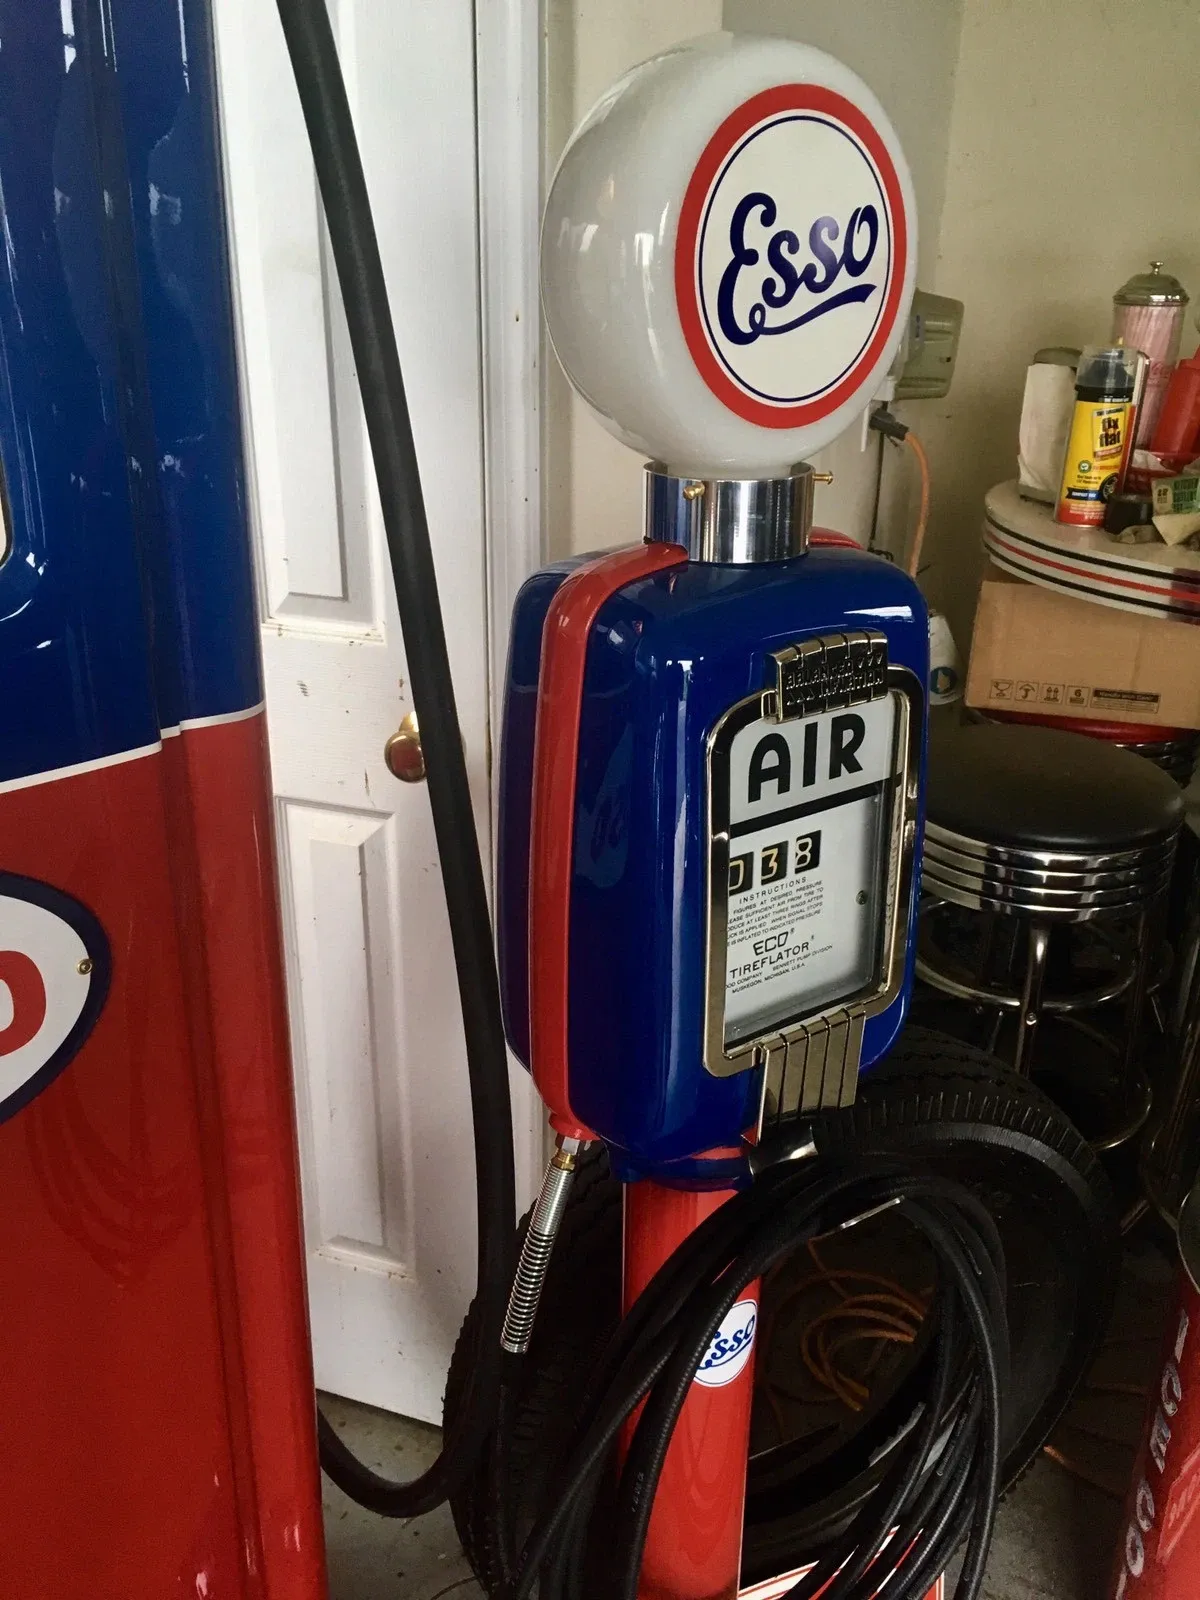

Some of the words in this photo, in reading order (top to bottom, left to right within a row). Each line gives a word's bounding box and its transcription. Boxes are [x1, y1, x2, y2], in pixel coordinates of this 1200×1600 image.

[717, 192, 879, 345] Esso
[748, 713, 866, 804] AIR
[733, 903, 757, 914] FIGURES
[770, 890, 793, 902] DESIRED
[796, 880, 822, 892] PRESSURE
[739, 876, 807, 905] INSTRUCTIONS
[745, 903, 775, 918] SUFFICIENT
[787, 895, 802, 904] FROM
[745, 921, 767, 933] APPLIED
[771, 915, 787, 923] WHEN
[787, 908, 805, 917] SIGNAL
[807, 901, 823, 910] STOPS
[754, 912, 771, 922] LEAST
[772, 907, 789, 916] THREE
[790, 900, 807, 909] RINGS
[807, 894, 824, 903] AFTER
[737, 931, 761, 943] INFLATED
[769, 919, 795, 931] INDICATED
[795, 909, 821, 922] PRESSURE
[729, 942, 809, 979] TIREFLATOR
[753, 931, 789, 956] ECO
[736, 972, 762, 985] COMPANY
[772, 959, 795, 971] BENNETT
[796, 953, 811, 961] PUMP
[812, 945, 833, 956] DIVISION
